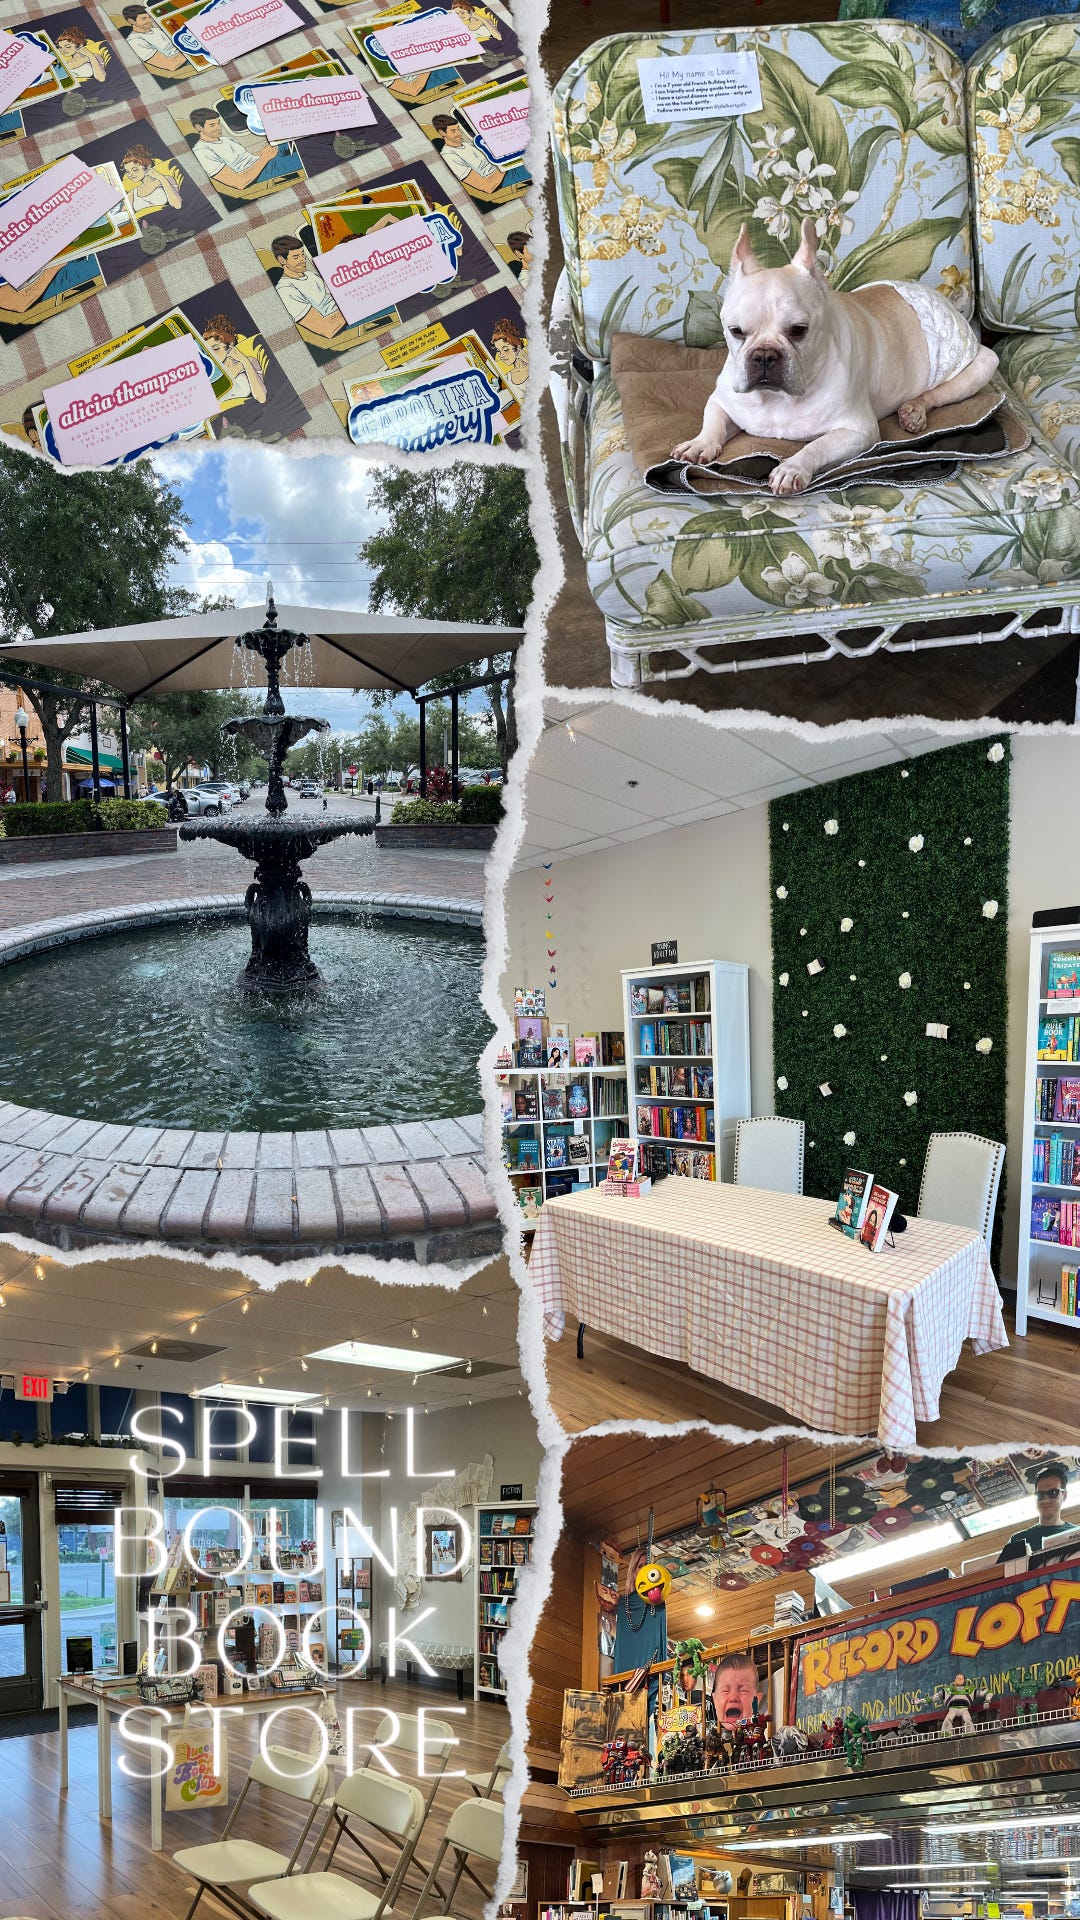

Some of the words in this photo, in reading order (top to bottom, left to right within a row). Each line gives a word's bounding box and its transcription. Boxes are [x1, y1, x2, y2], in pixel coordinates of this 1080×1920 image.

[201, 20, 234, 41] alicia
[232, 0, 283, 27] thompson
[391, 39, 443, 59] thompson
[441, 33, 471, 48] alicia
[672, 70, 683, 81] My
[263, 97, 302, 113] alicia
[300, 90, 362, 108] thompson
[479, 112, 510, 130] alicia
[25, 171, 93, 225] thompson
[331, 260, 371, 288] alicia
[369, 234, 433, 270] thompson
[59, 393, 116, 430] alicia
[113, 360, 199, 406] thompson
[361, 379, 491, 434] CAROLINA
[22, 1376, 49, 1398] EXIT
[502, 1487, 521, 1495] FICTION
[802, 1617, 940, 1696] RECORD
[951, 1579, 1080, 1658] LOFT
[862, 1701, 885, 1720] DVD
[181, 1773, 222, 1802] Club
